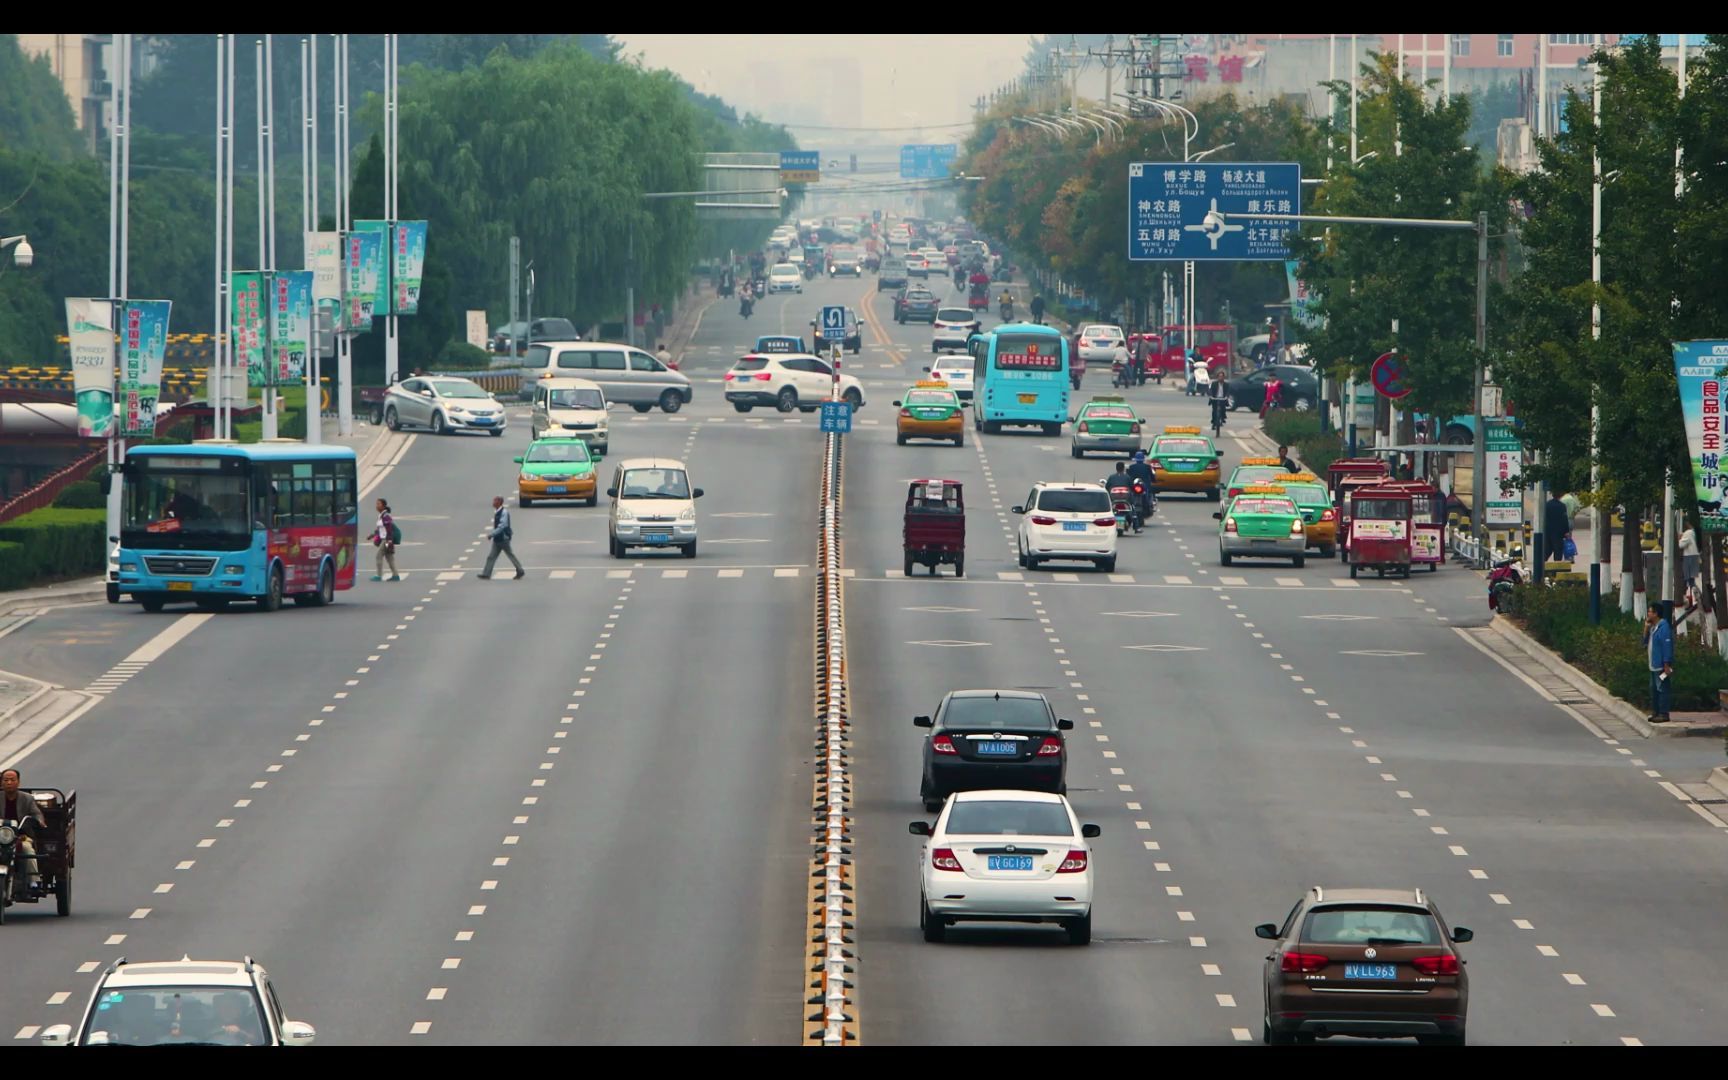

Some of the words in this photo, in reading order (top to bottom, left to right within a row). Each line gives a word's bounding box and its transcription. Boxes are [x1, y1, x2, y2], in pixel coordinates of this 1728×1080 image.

[1184, 54, 1245, 82] 宾馆
[1163, 169, 1206, 183] 博学路
[1222, 169, 1266, 183] 杨凌大道
[1137, 199, 1181, 213] 神农路
[1247, 199, 1291, 213] 康乐路
[1137, 228, 1181, 241] 五胡路
[824, 405, 848, 416] 注意
[823, 418, 848, 430] 车辆
